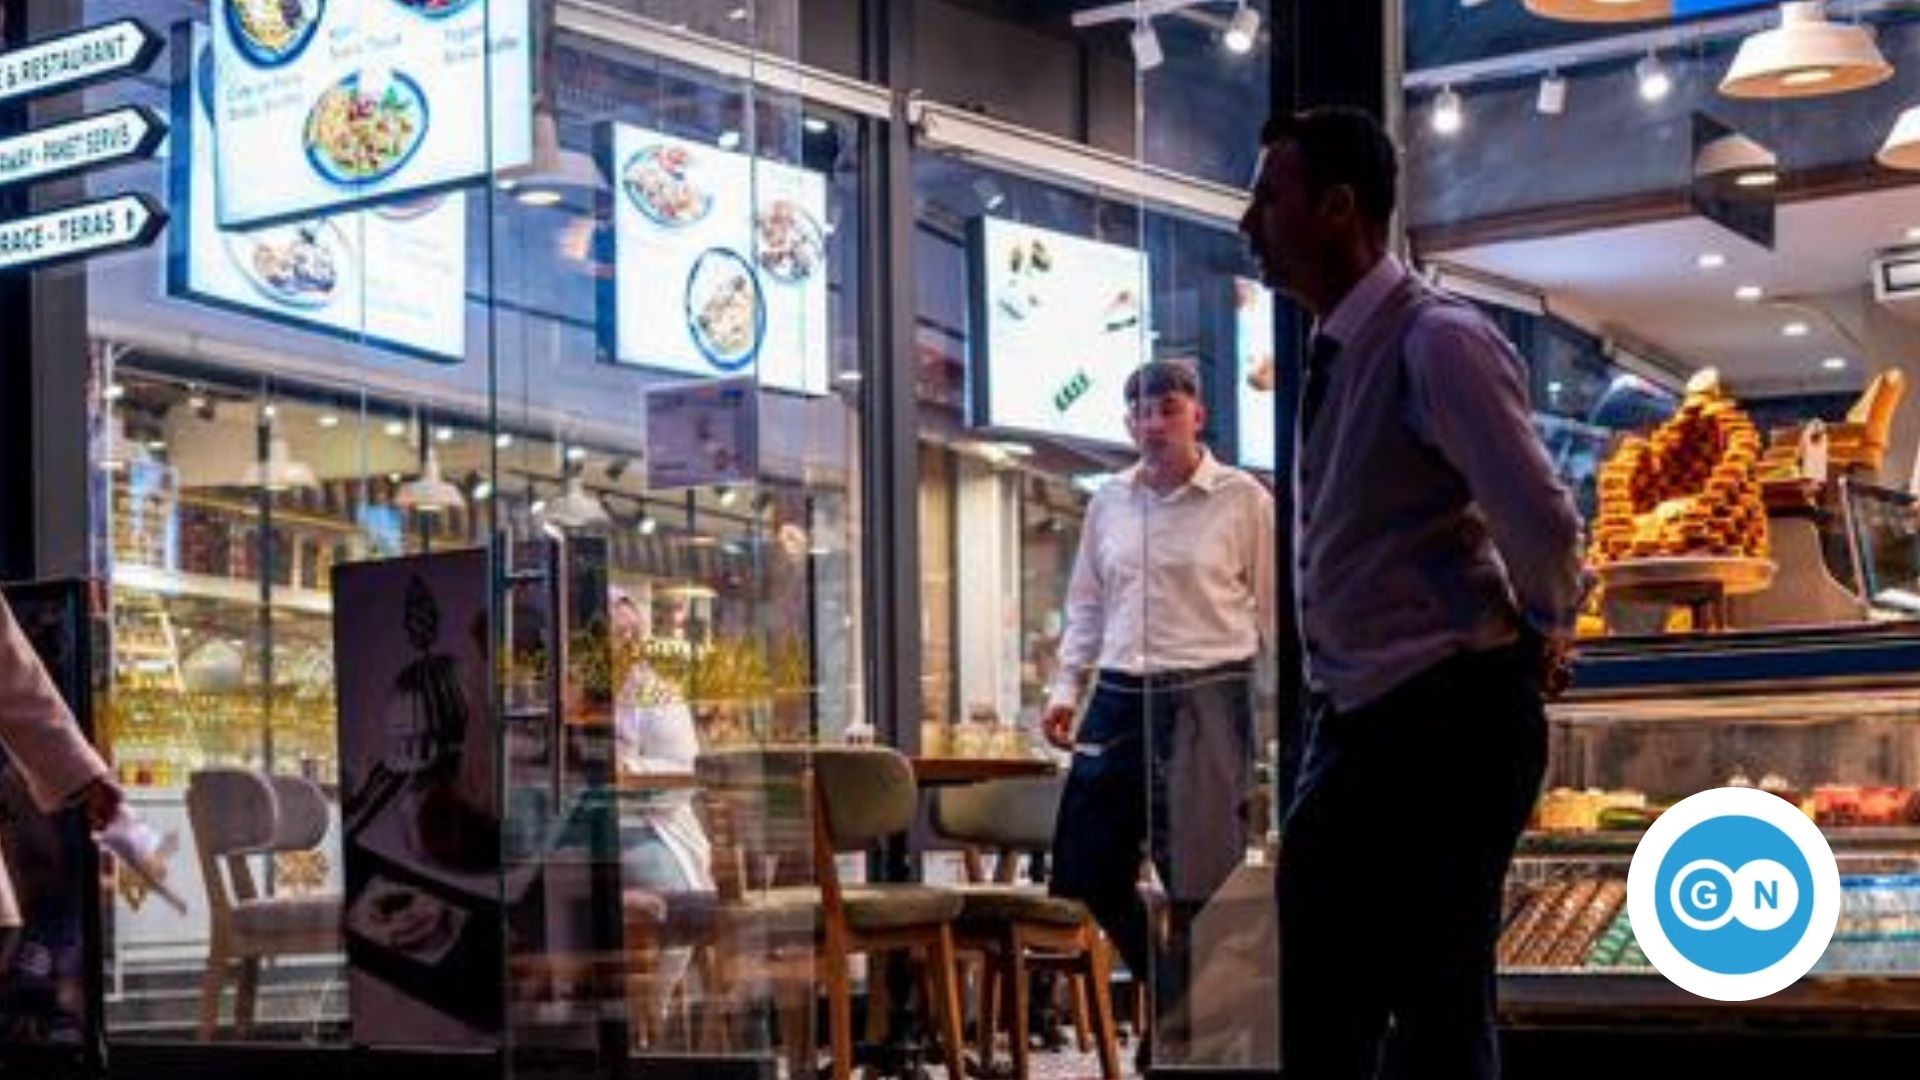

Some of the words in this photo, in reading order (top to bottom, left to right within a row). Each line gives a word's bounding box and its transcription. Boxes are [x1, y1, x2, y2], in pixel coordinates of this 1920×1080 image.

[22, 34, 125, 80] RESTAURANT
[86, 121, 131, 155] SERVIS
[58, 208, 115, 242] TERAS
